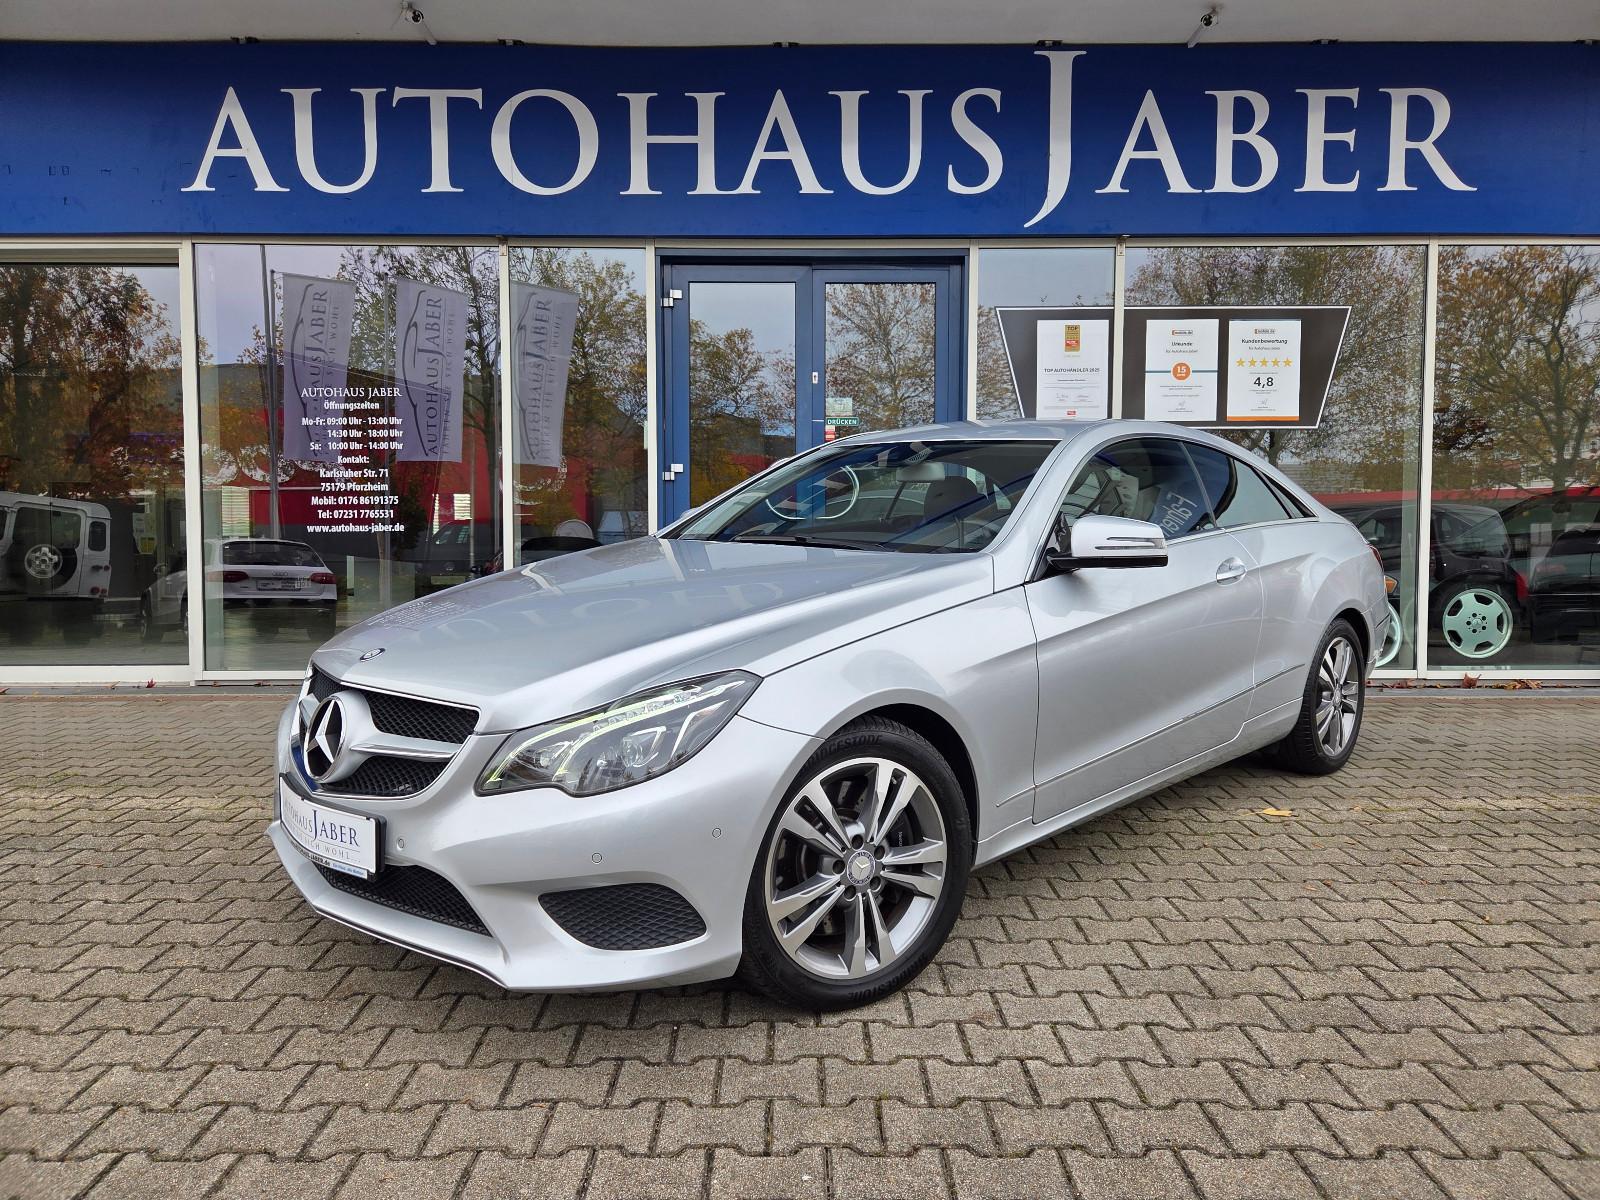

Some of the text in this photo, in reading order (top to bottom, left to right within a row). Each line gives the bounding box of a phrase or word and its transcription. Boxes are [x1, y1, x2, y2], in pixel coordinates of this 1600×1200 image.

[181, 50, 1478, 228] AUTOHAUS JABER
[304, 290, 328, 355] JABER
[523, 300, 552, 361] JABER
[417, 297, 446, 455] AUTOHAUS JABER
[1253, 377, 1274, 388] 4,8
[301, 387, 365, 397] AUTOHAUS
[368, 387, 402, 399] JABER
[324, 400, 380, 411] Öffnungszeiten
[301, 417, 326, 426] Mo-Fr:
[326, 417, 347, 426] 09:00
[349, 417, 362, 425] Uhr
[368, 417, 387, 425] 13:00
[389, 417, 403, 425] Uhr
[328, 430, 348, 438] 14:30
[349, 430, 362, 438] Uhr
[310, 442, 322, 451] Sa:
[328, 442, 348, 450] 10:00
[350, 442, 363, 450] Uhr
[369, 442, 389, 450] 14:00
[390, 442, 403, 450] Uhr
[338, 455, 370, 464] Kontakt:
[320, 468, 388, 478] Karlsruher Str. 71
[320, 482, 388, 491] 75179 Pforzheim
[311, 496, 398, 506] Mobil: 0176 86191375
[318, 510, 394, 518] Tel: 07231 7765531
[306, 522, 405, 533] www.autohaus-jaber.de
[312, 809, 360, 847] JABER
